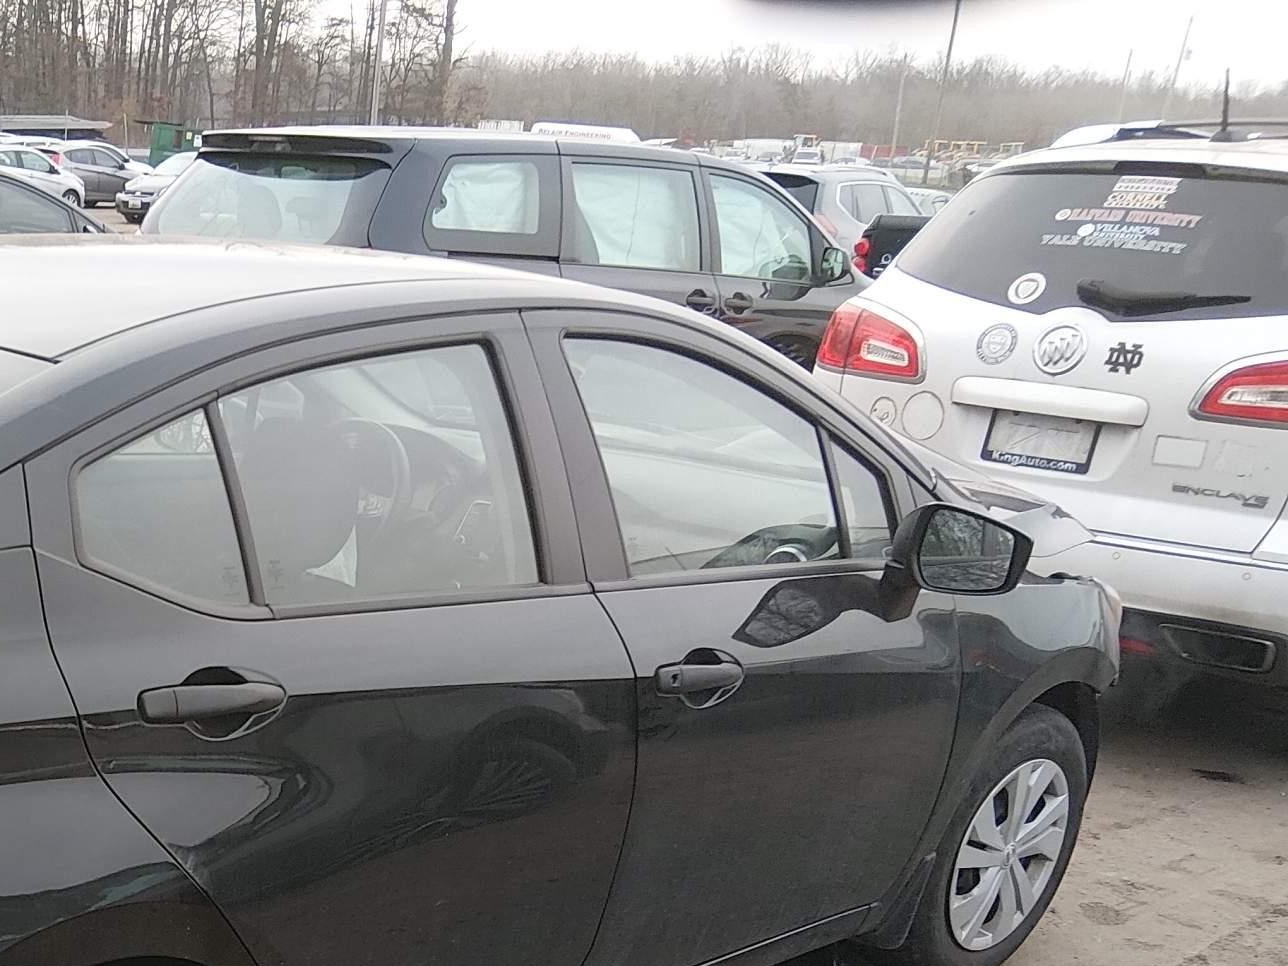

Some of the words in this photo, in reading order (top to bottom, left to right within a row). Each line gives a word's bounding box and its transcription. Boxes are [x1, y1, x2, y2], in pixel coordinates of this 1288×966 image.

[1094, 223, 1161, 236] VILLANOVA
[992, 450, 1077, 471] KingAuto.com
[1172, 485, 1269, 504] ENCLAVE
